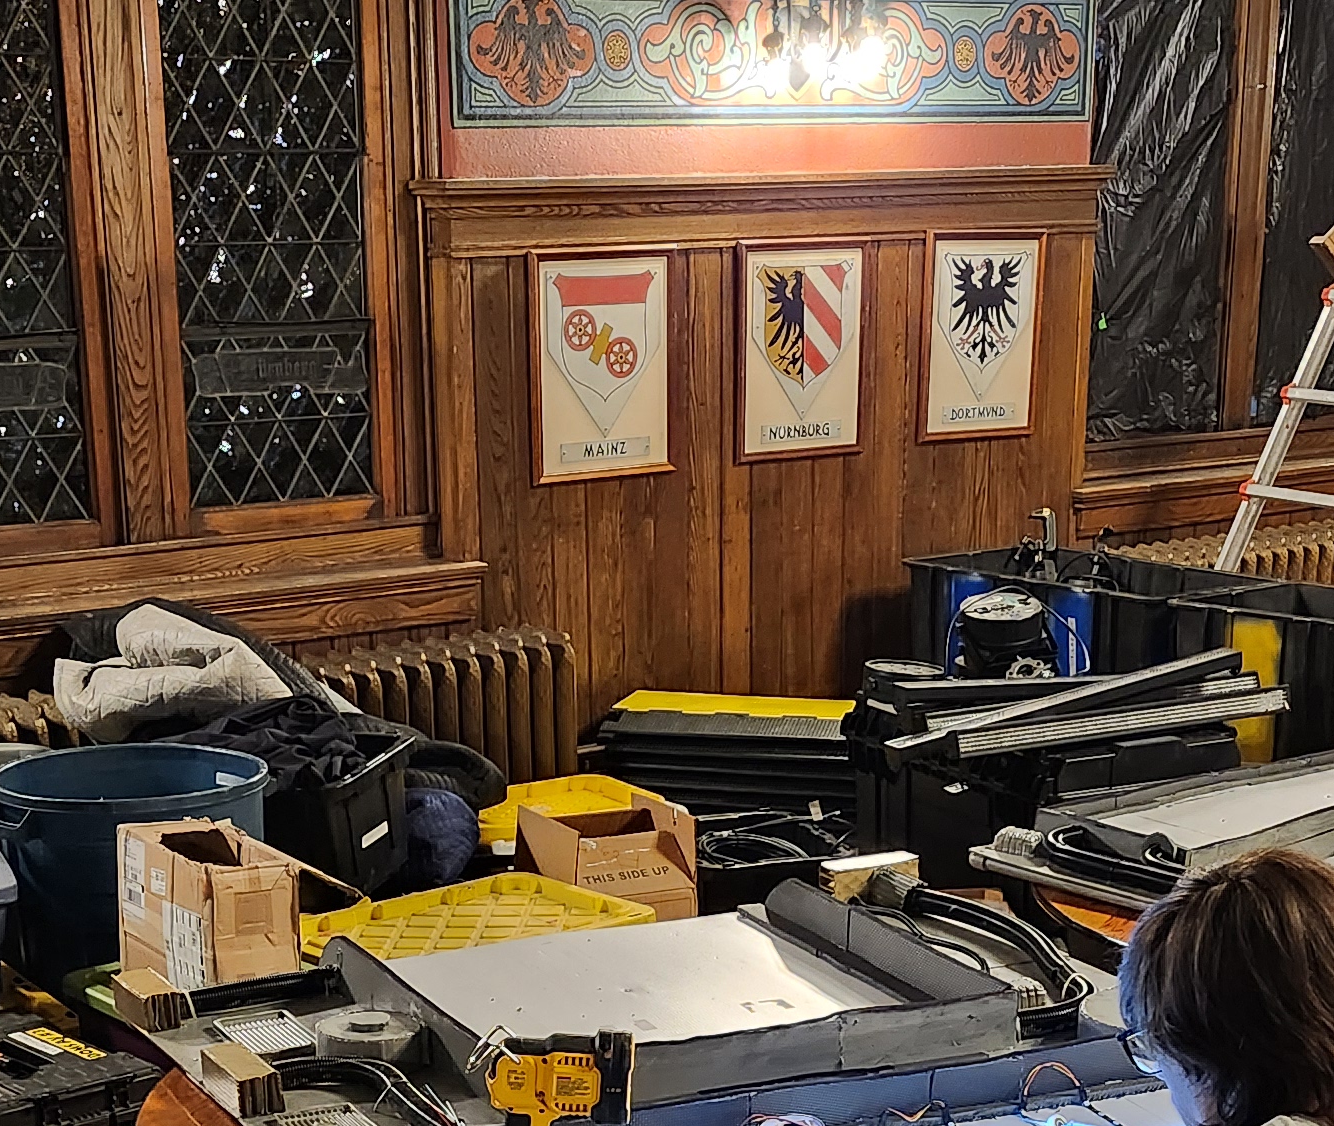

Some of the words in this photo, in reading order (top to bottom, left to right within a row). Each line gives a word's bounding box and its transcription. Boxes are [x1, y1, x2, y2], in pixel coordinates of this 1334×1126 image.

[769, 422, 830, 440] NURNBURG
[583, 441, 627, 458] MAINZ
[582, 873, 616, 885] THIS
[618, 868, 649, 880] SIDE
[651, 865, 670, 876] UP
